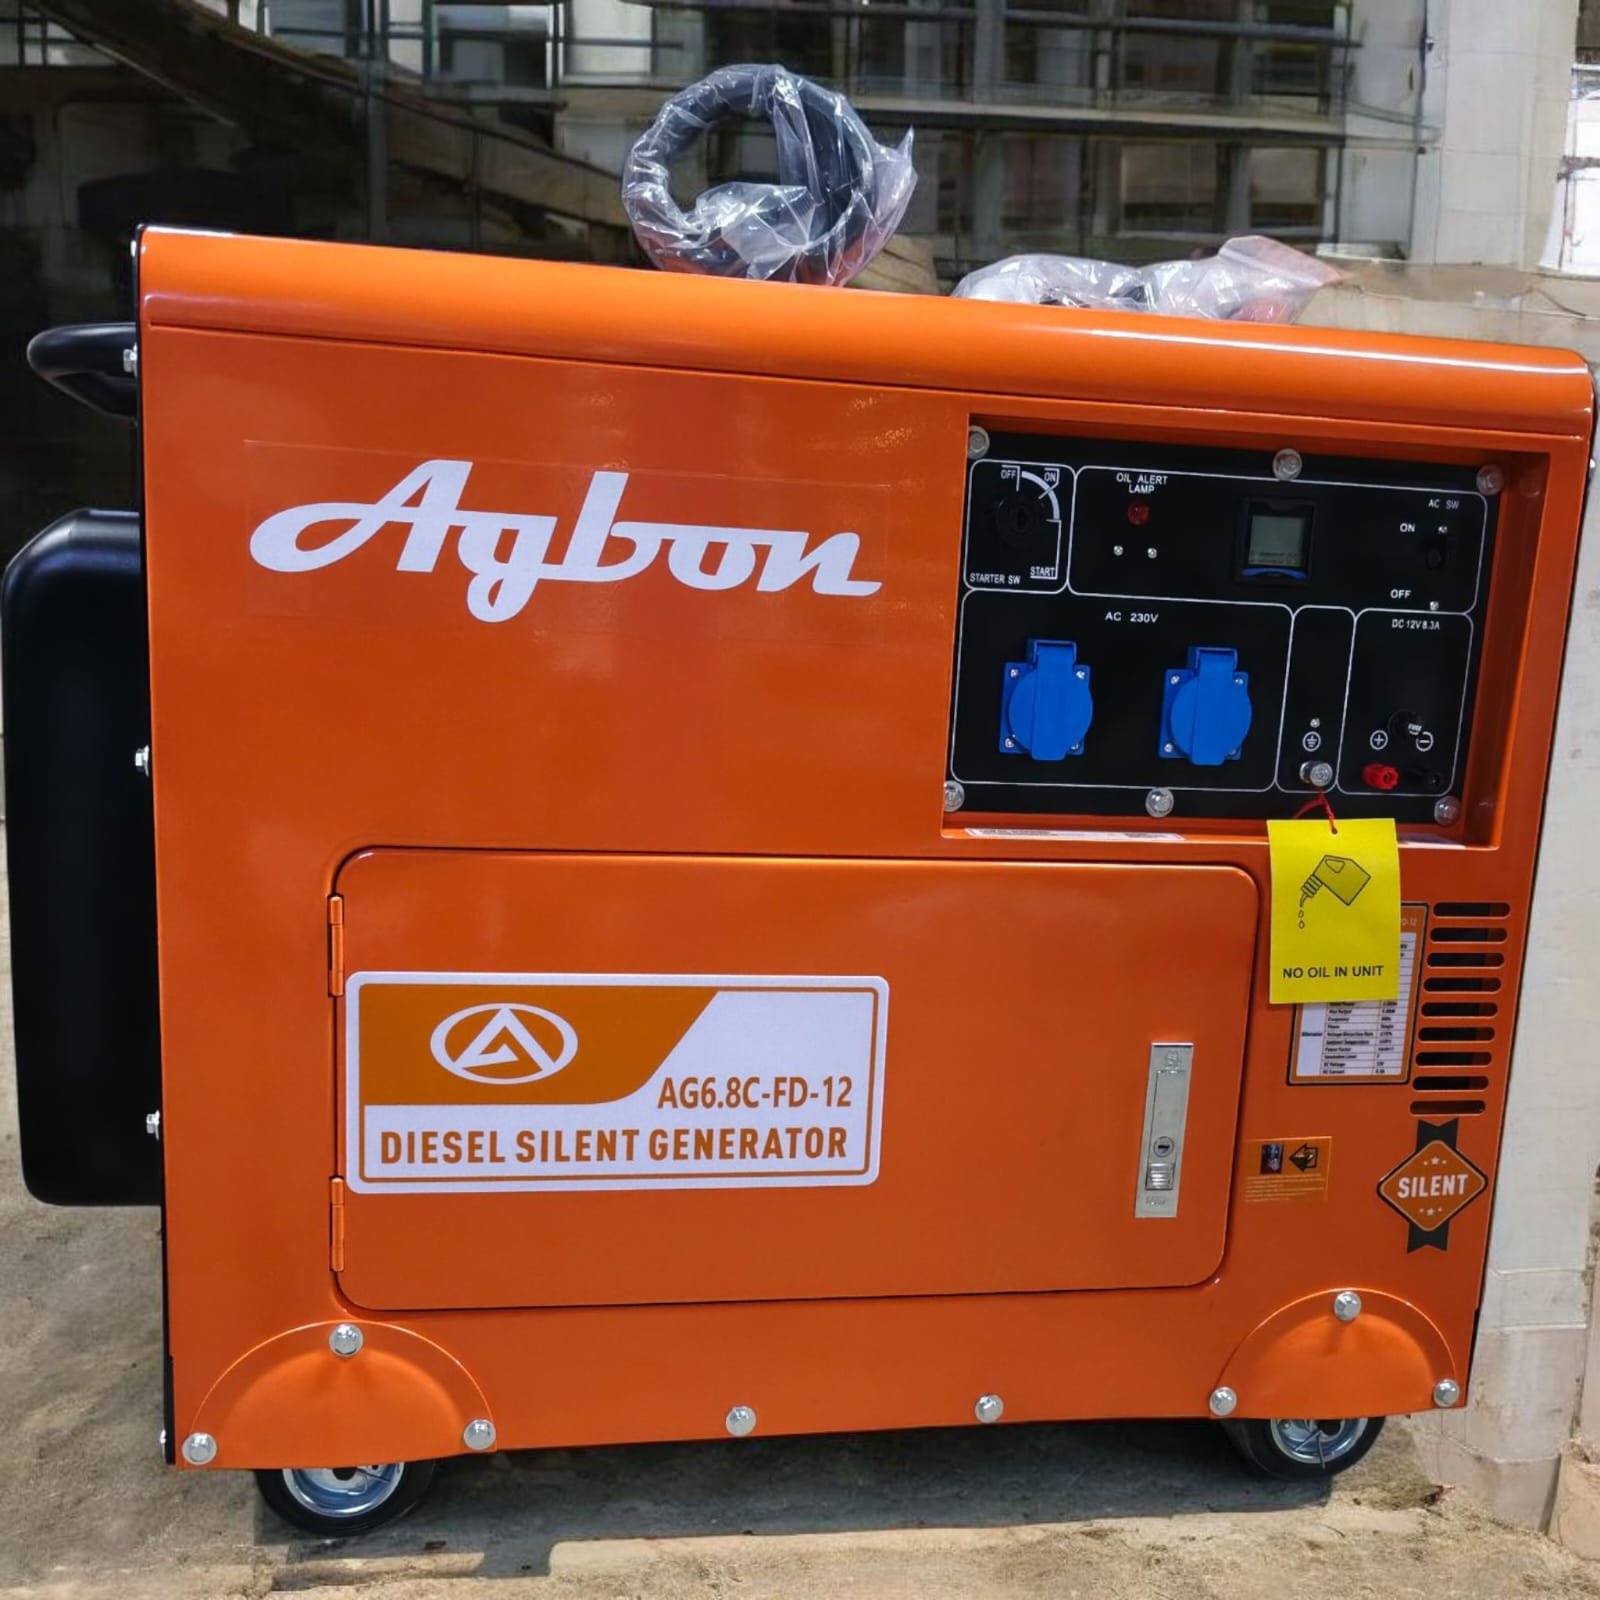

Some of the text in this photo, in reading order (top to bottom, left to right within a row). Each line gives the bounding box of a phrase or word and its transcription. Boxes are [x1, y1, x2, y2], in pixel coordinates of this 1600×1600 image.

[1001, 469, 1016, 480] OFF
[1044, 472, 1056, 482] ON
[1116, 472, 1168, 485] OIL ALERT
[1128, 484, 1155, 494] LAMP
[1428, 499, 1459, 509] AC SW
[1400, 523, 1415, 532] ON
[250, 459, 882, 623] Agbon
[1030, 566, 1055, 577] START
[970, 573, 1021, 584] STARTER SW
[1390, 589, 1411, 599] OFF
[1105, 612, 1158, 623] AC 230V
[1391, 619, 1404, 628] DC
[1406, 619, 1422, 629] 12V
[1283, 965, 1384, 978] NO OIL IN UNIT
[657, 1076, 853, 1109] AG6.8C-FD-12
[380, 1127, 847, 1164] DIESEL SILENT GENERATOR
[1397, 1174, 1468, 1198] SILENT
